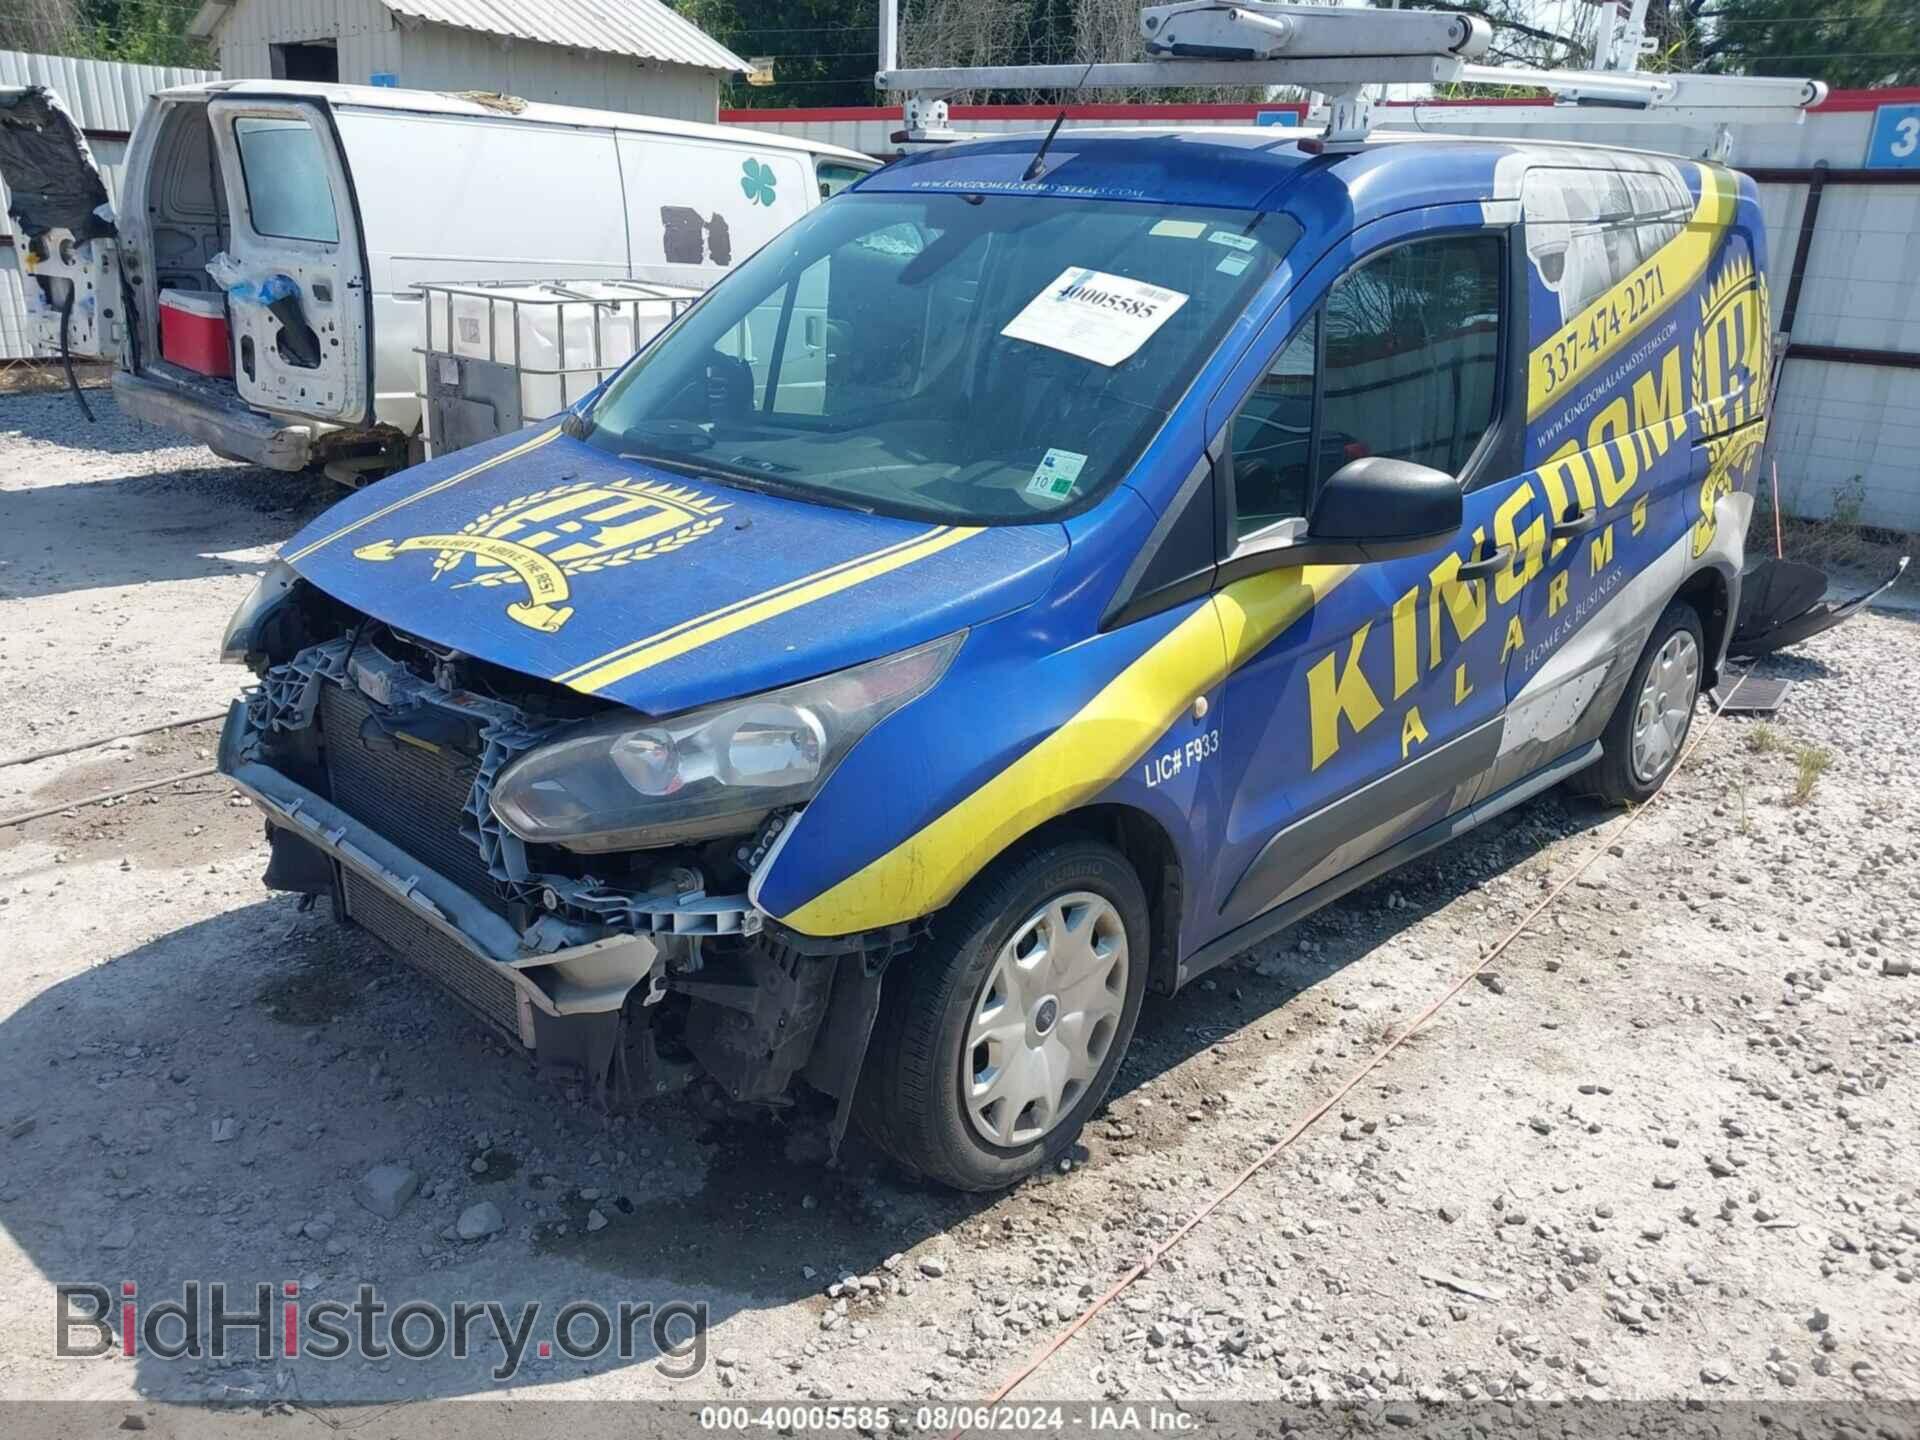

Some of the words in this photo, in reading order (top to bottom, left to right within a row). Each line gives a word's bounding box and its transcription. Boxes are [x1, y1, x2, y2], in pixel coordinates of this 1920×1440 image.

[1891, 117, 1920, 158] 3
[1058, 285, 1158, 319] 40005585
[1541, 264, 1665, 393] 337-474-2271
[1034, 476, 1049, 488] 10
[524, 559, 541, 574] THE
[534, 572, 556, 595] REST
[1306, 344, 1688, 772] KINGDOM
[1401, 494, 1648, 759] ALARMS
[1524, 626, 1561, 672] HOME
[1575, 565, 1622, 622] BUSINESS
[1144, 747, 1183, 788] LIC#
[1185, 729, 1219, 768] F933
